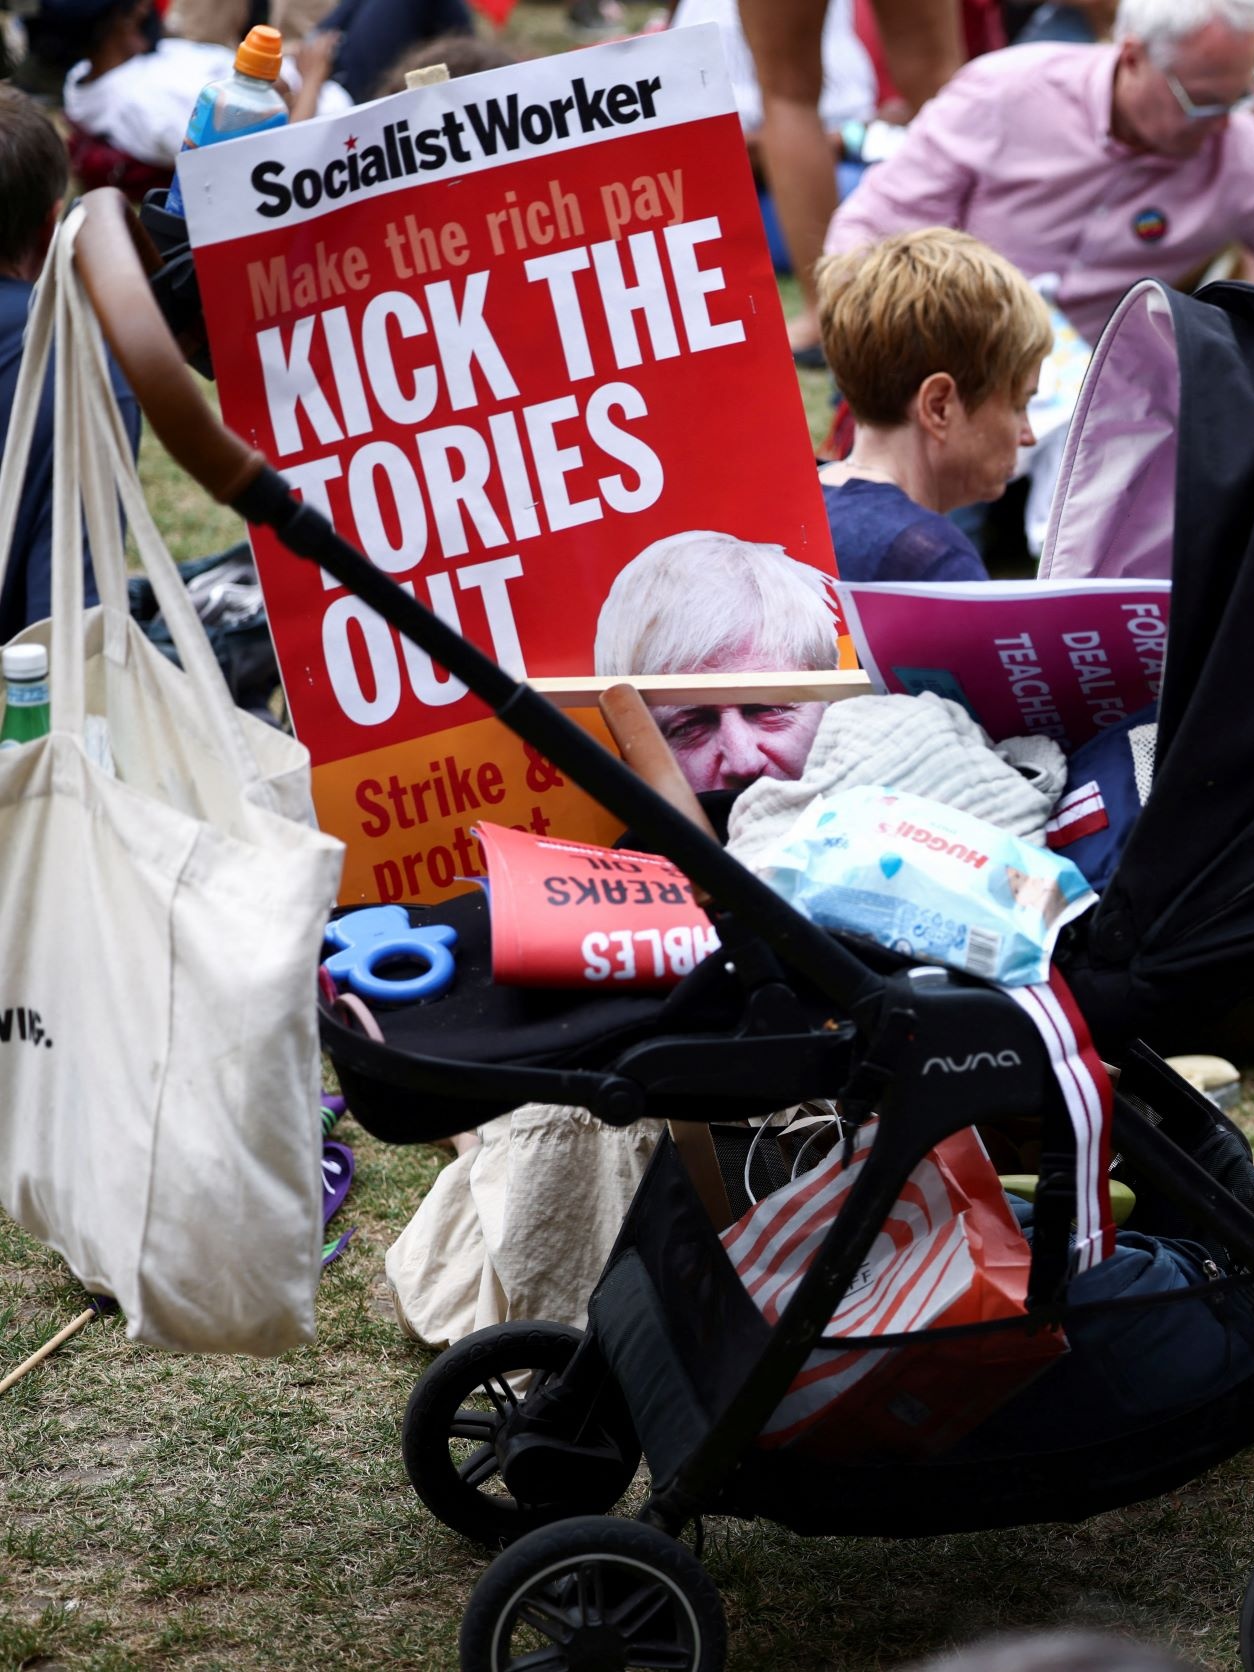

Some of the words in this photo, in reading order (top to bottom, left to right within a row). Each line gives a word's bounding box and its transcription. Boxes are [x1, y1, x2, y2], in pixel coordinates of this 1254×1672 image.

[246, 242, 371, 321] Make
[384, 214, 471, 279] the
[486, 179, 585, 255] rich
[600, 168, 685, 241] pay
[256, 270, 521, 457] KICK
[524, 216, 746, 382] THE
[277, 381, 665, 591] TORIES
[321, 555, 528, 726] OUT
[1060, 630, 1116, 694] DEAL
[1119, 602, 1168, 653] FOR
[1086, 697, 1128, 733] FO
[355, 756, 506, 838] Strike
[544, 876, 693, 906] REAKS
[922, 1049, 1022, 1075] nuna
